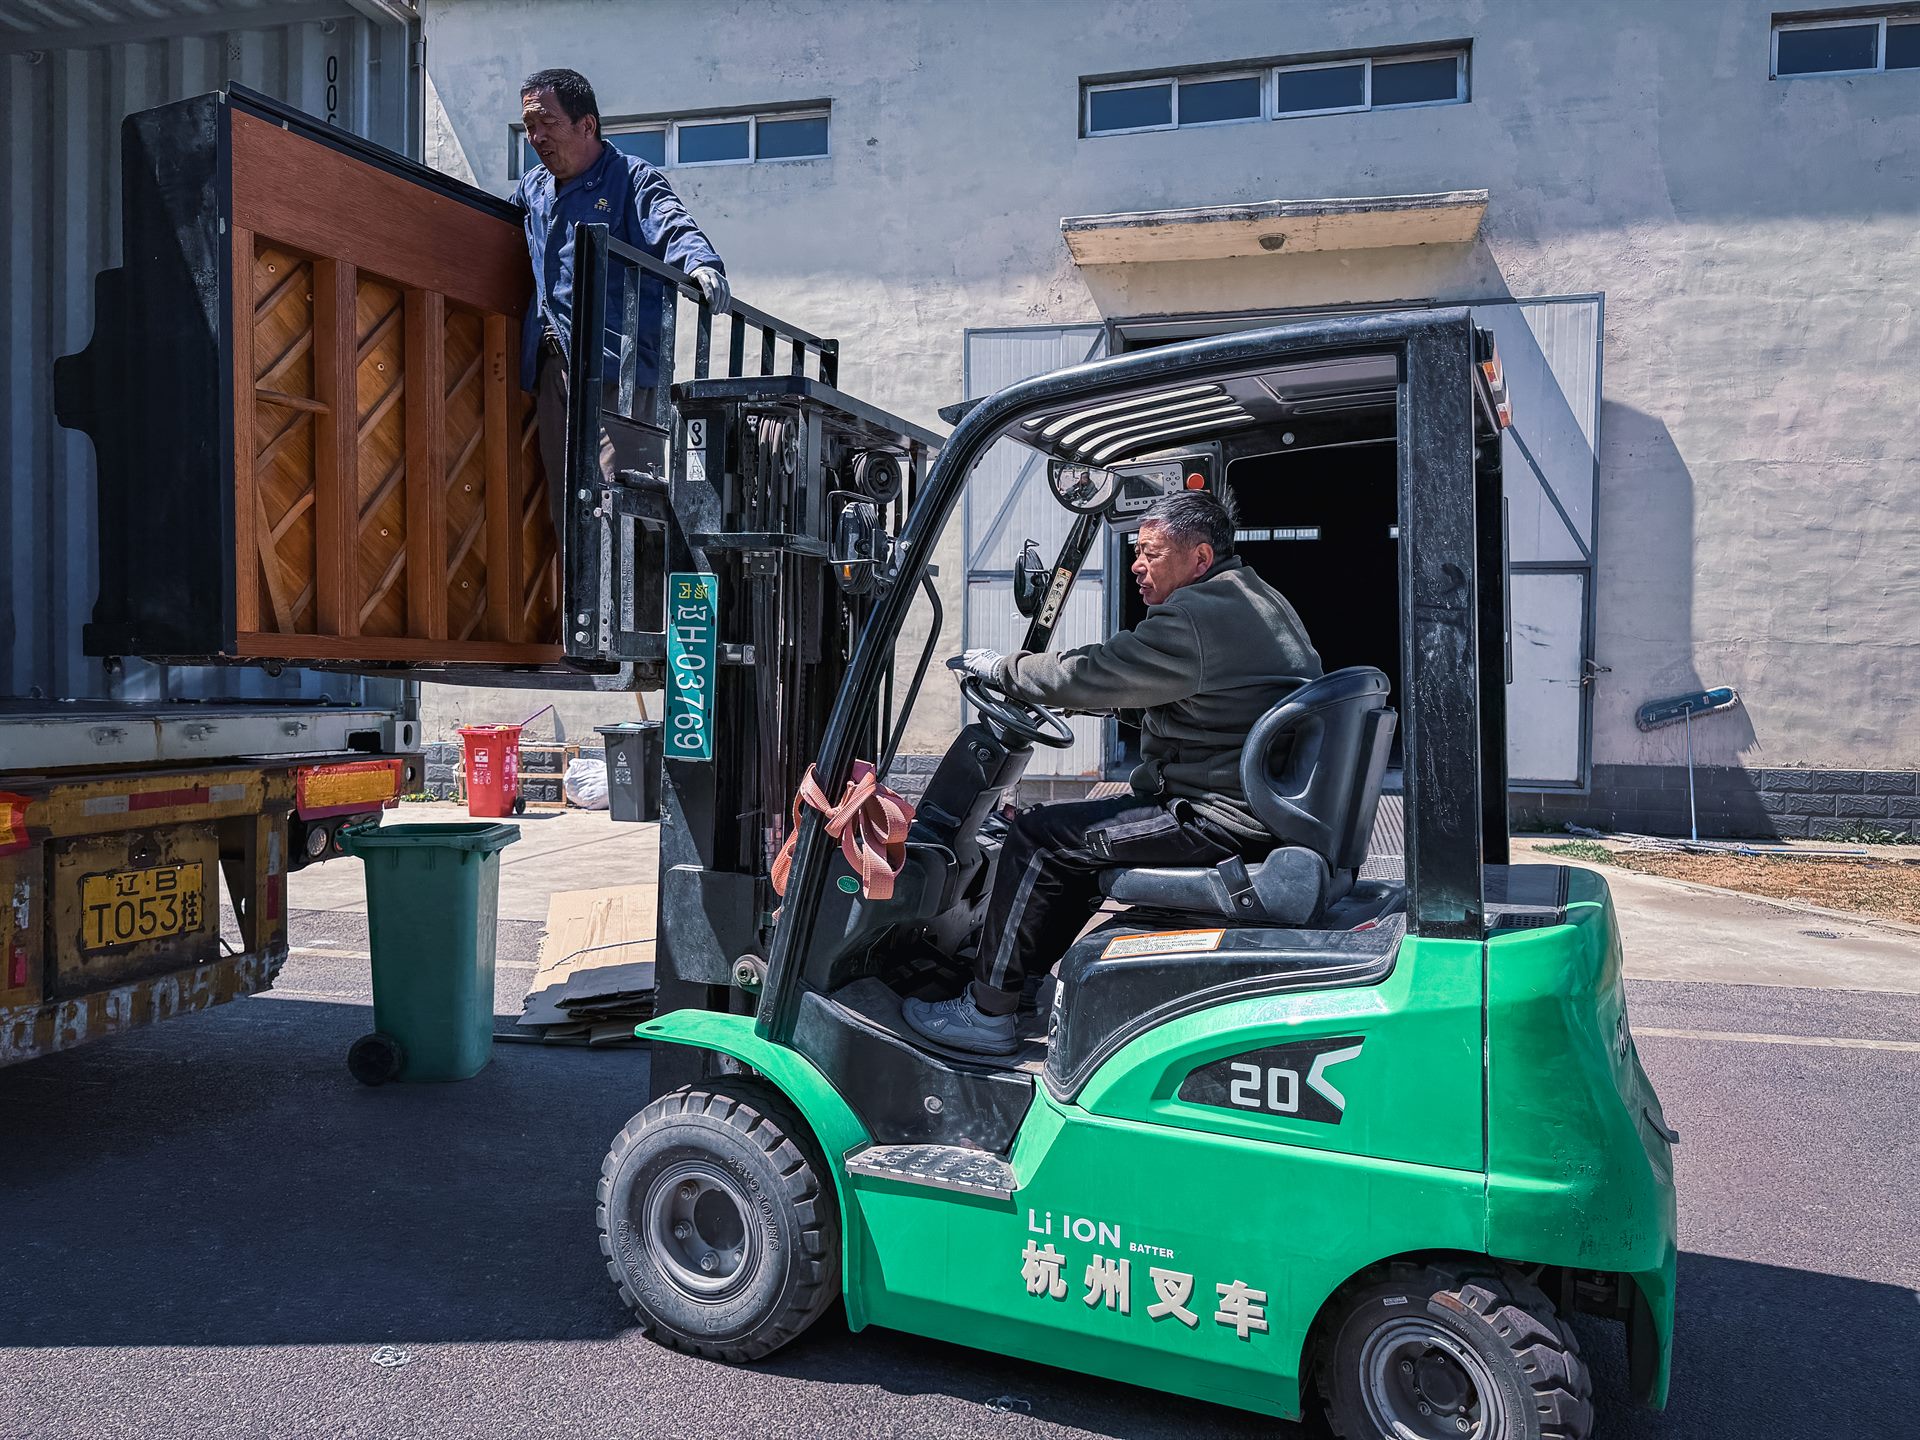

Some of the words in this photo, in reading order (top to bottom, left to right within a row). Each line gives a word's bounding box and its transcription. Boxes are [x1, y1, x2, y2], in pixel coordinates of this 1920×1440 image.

[326, 55, 338, 124] 00
[678, 582, 708, 599] 场内
[89, 890, 197, 943] T053挂
[1230, 1062, 1299, 1112] 20
[1028, 1208, 1051, 1235] Li
[1063, 1215, 1121, 1248] ION
[1129, 1242, 1174, 1259] BATTER
[1021, 1239, 1268, 1338] 杭州叉车
